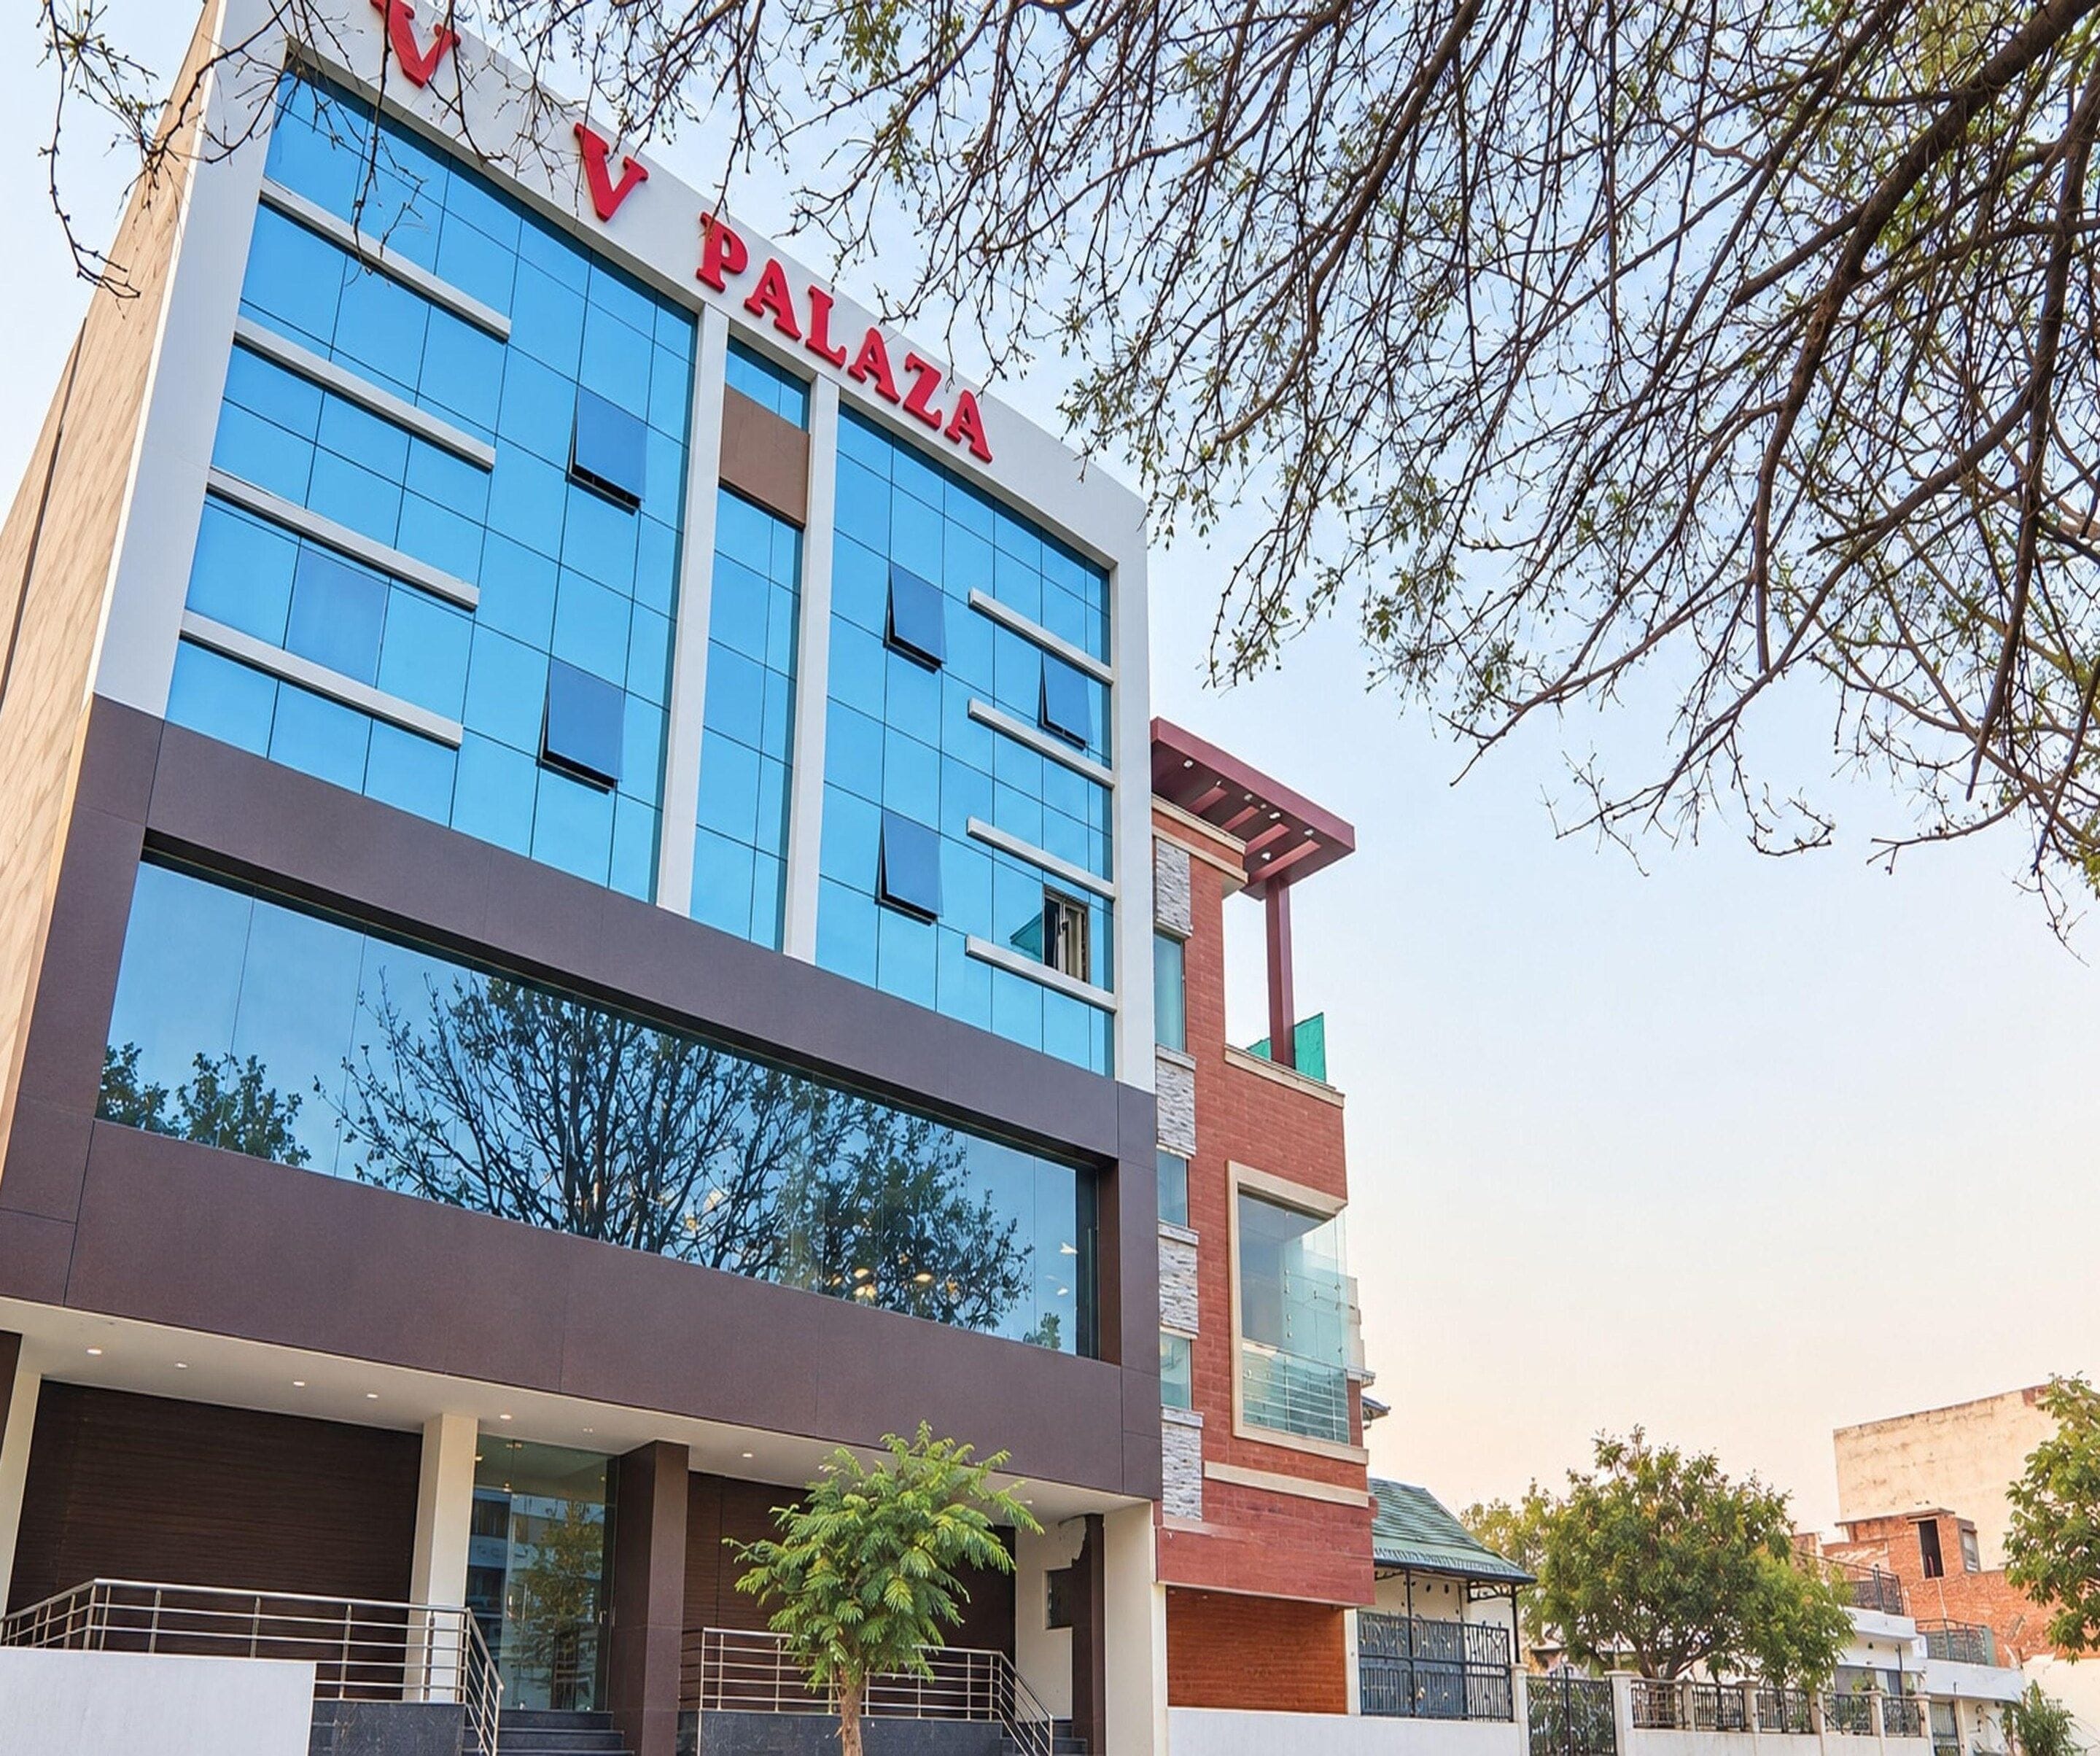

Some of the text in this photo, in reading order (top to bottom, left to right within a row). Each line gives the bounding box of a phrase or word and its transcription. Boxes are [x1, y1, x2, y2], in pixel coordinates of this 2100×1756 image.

[370, 0, 993, 462] V V PALAZA
